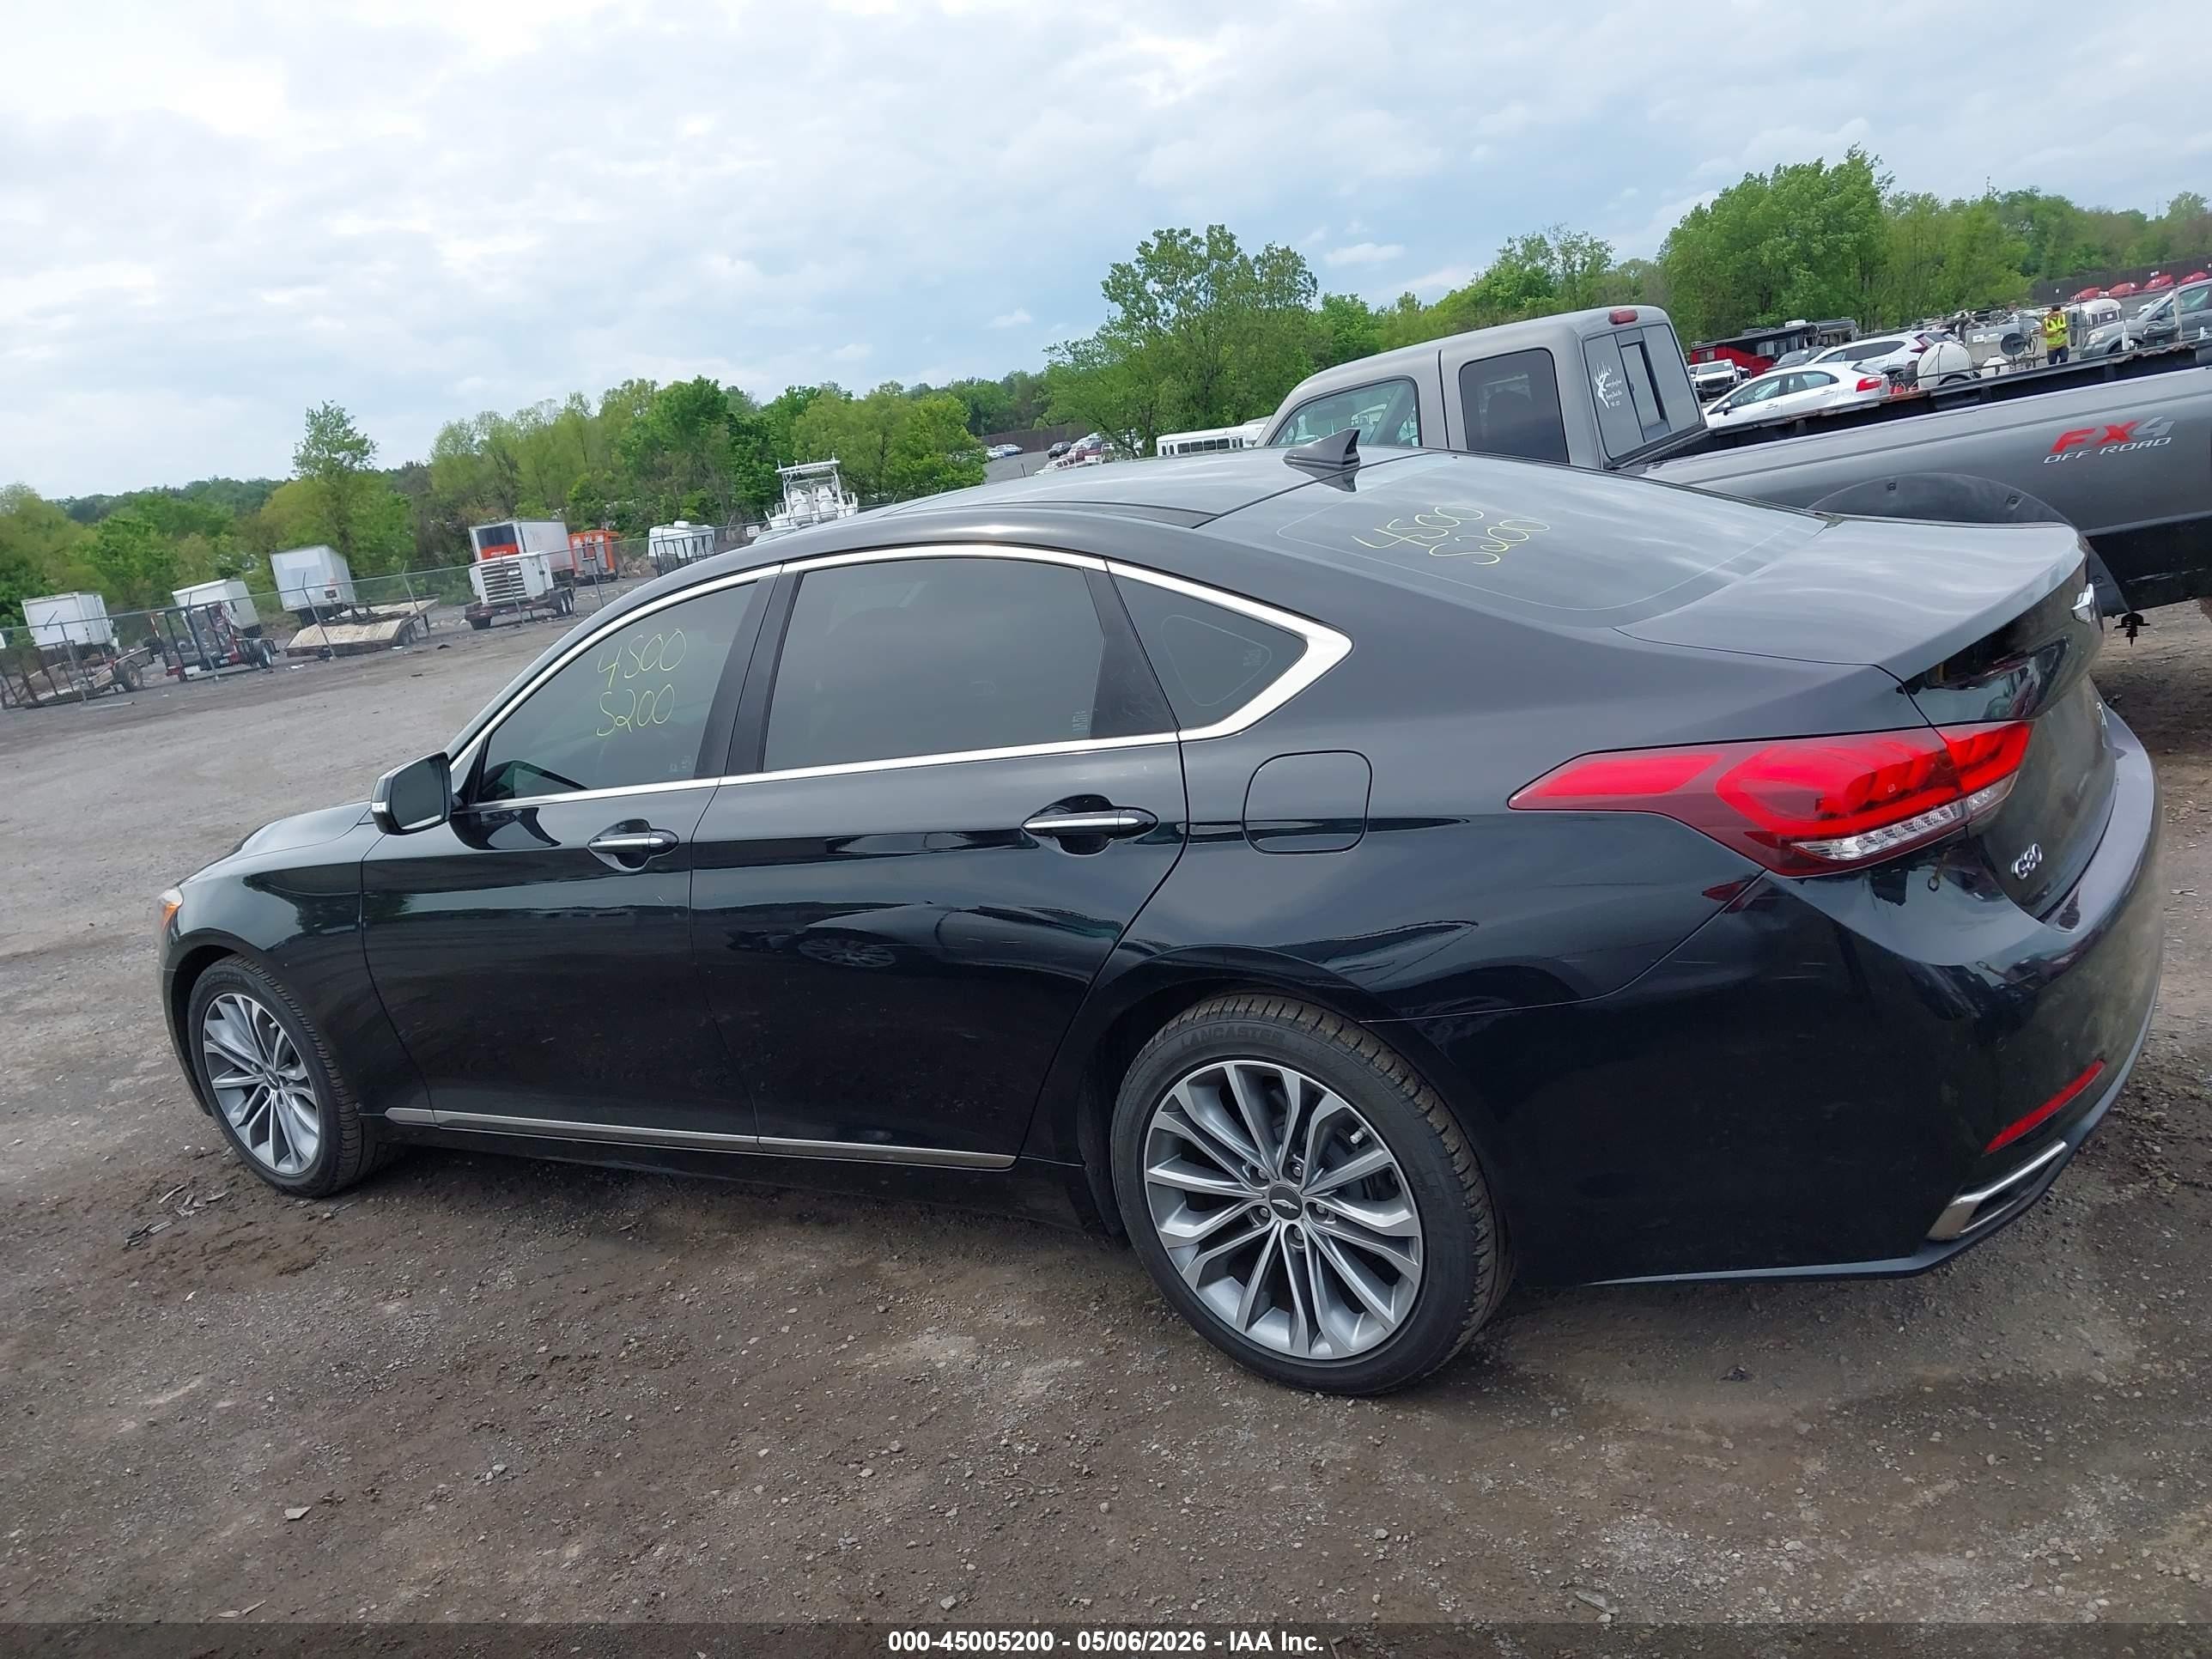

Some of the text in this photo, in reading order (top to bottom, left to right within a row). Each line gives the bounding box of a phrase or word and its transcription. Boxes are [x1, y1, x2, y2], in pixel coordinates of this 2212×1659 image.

[2043, 436, 2172, 464] OFF ROAD
[2050, 416, 2176, 453] FX4
[1350, 506, 1485, 549] 4500
[597, 628, 687, 689] 4500
[596, 684, 675, 737] 5200
[2011, 842, 2043, 880] G80
[1181, 1025, 1286, 1050] LANCASTER
